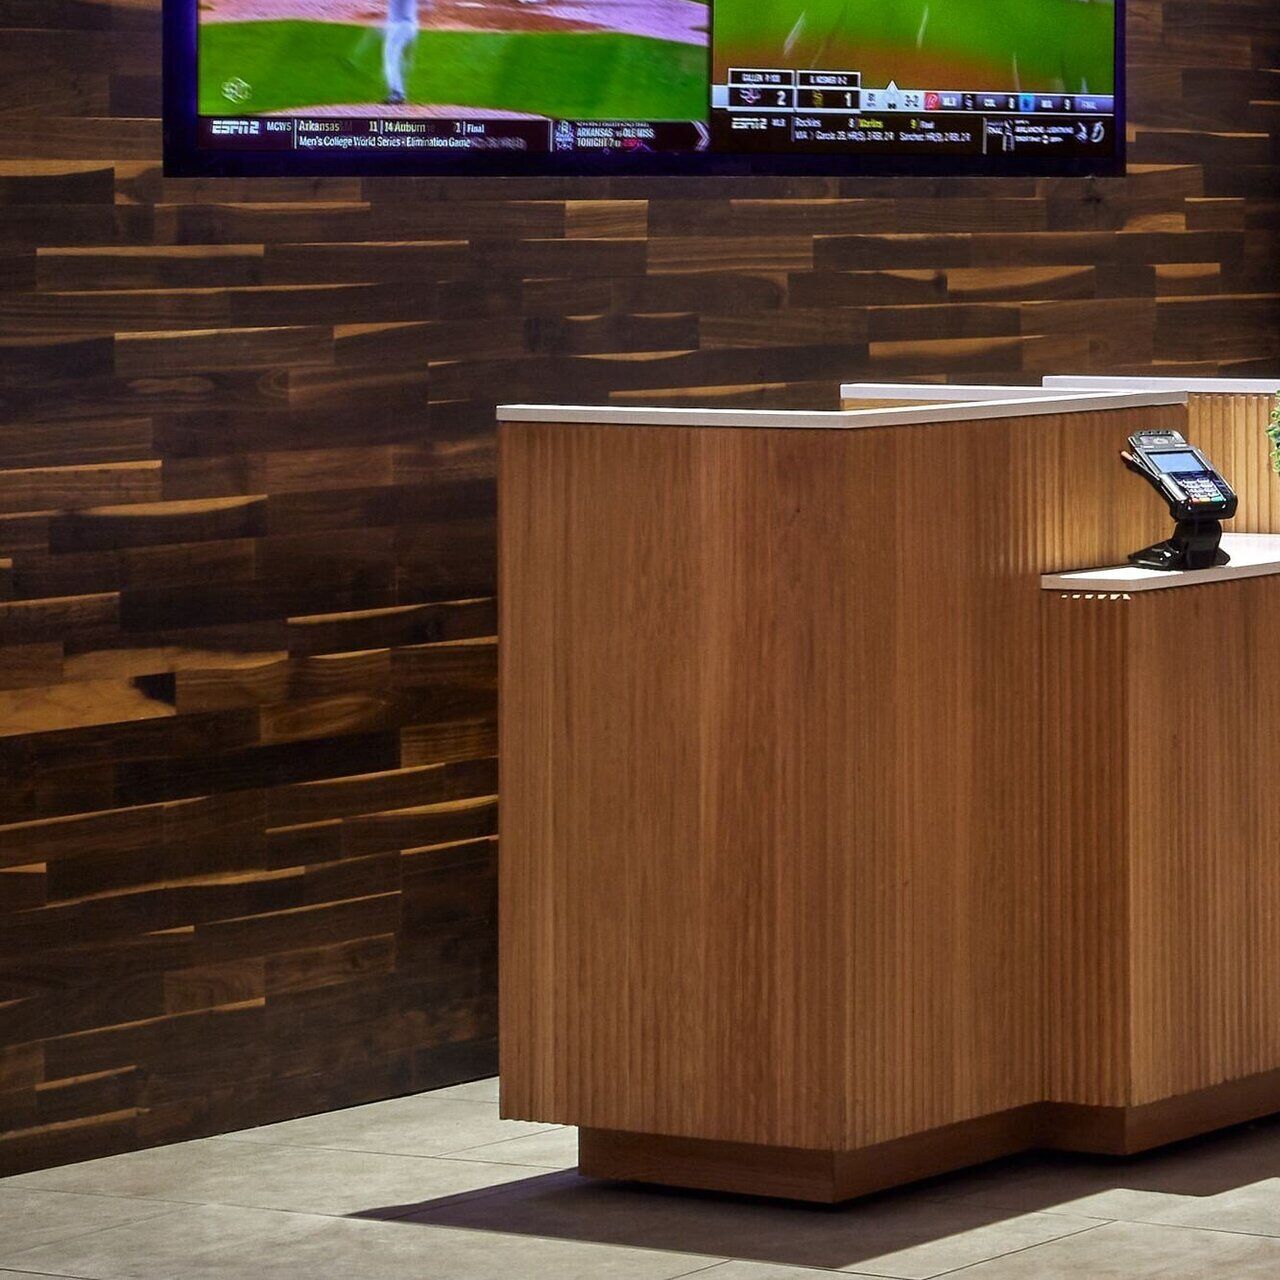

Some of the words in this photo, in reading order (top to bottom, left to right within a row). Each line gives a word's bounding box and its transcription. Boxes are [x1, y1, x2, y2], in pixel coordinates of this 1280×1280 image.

[776, 93, 786, 106] 2
[844, 93, 852, 107] 1
[212, 120, 259, 134] ESPN2
[267, 121, 292, 131] MCWS
[299, 120, 340, 131] Arkansas
[369, 121, 378, 131] 11
[394, 121, 426, 132] Auburn
[466, 123, 485, 133] Final
[577, 128, 613, 138] ARKANSAS
[299, 135, 321, 146] Men's
[323, 135, 353, 148] College
[353, 136, 376, 146] World
[377, 136, 400, 147] Series
[406, 136, 448, 148] Elimination
[448, 137, 470, 148] Game
[577, 137, 608, 148] TONIGHT
